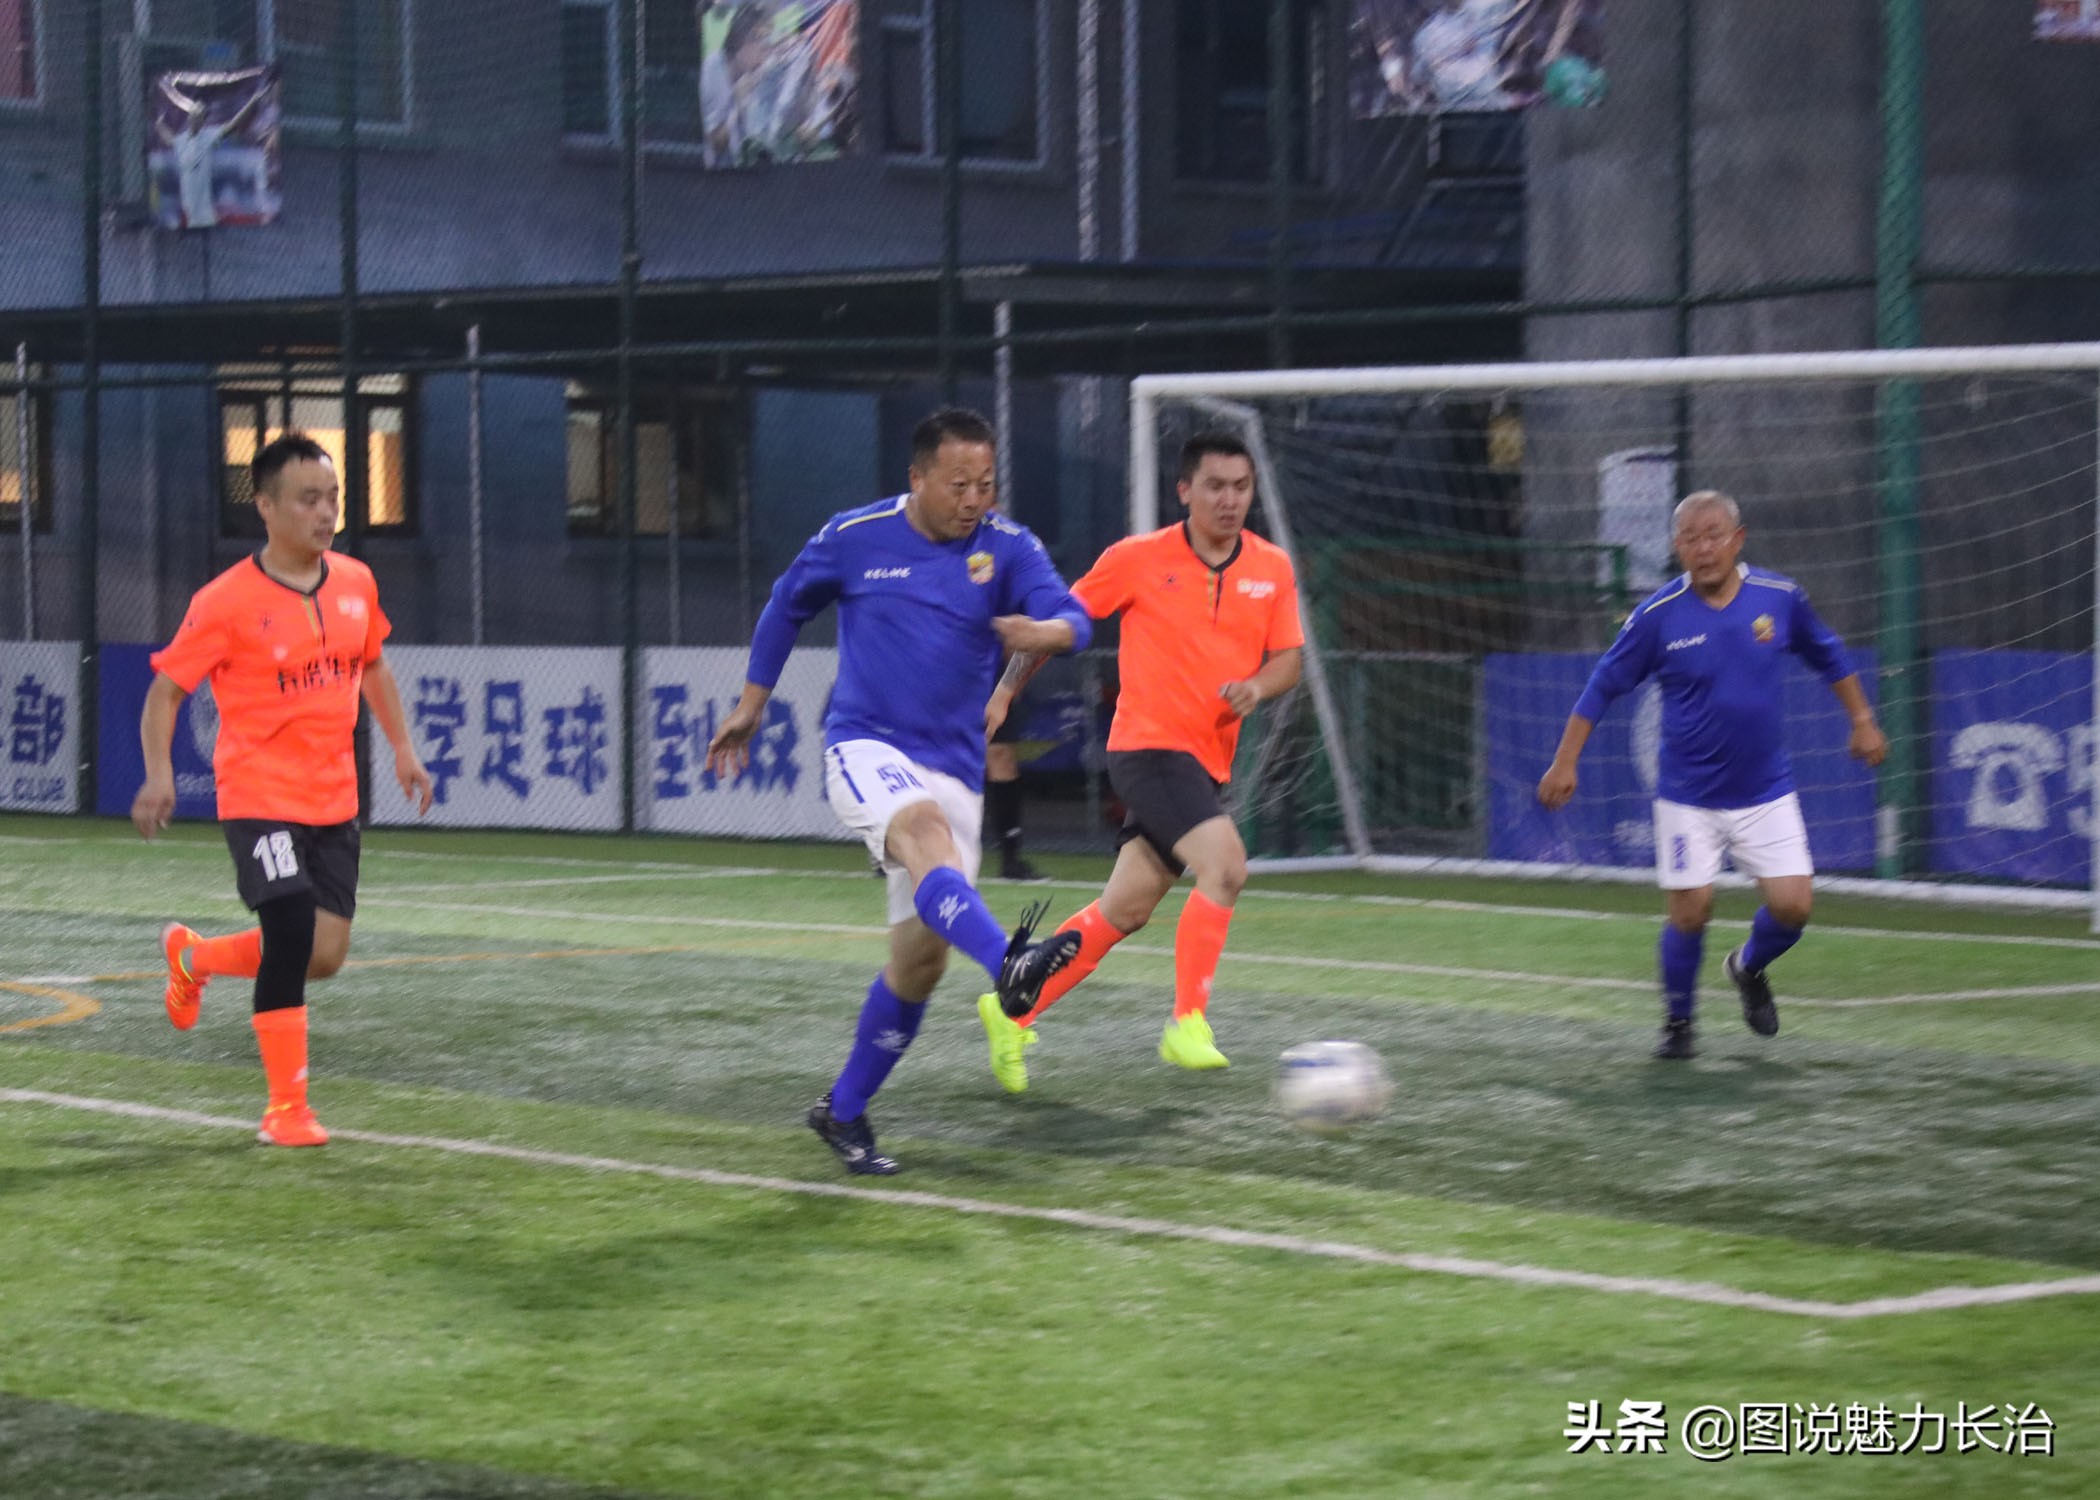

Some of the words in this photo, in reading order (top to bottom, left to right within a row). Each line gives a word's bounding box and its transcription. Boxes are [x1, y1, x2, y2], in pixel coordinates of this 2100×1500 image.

[10, 674, 66, 766] 部
[414, 675, 608, 805] 学足球
[252, 830, 299, 882] 18
